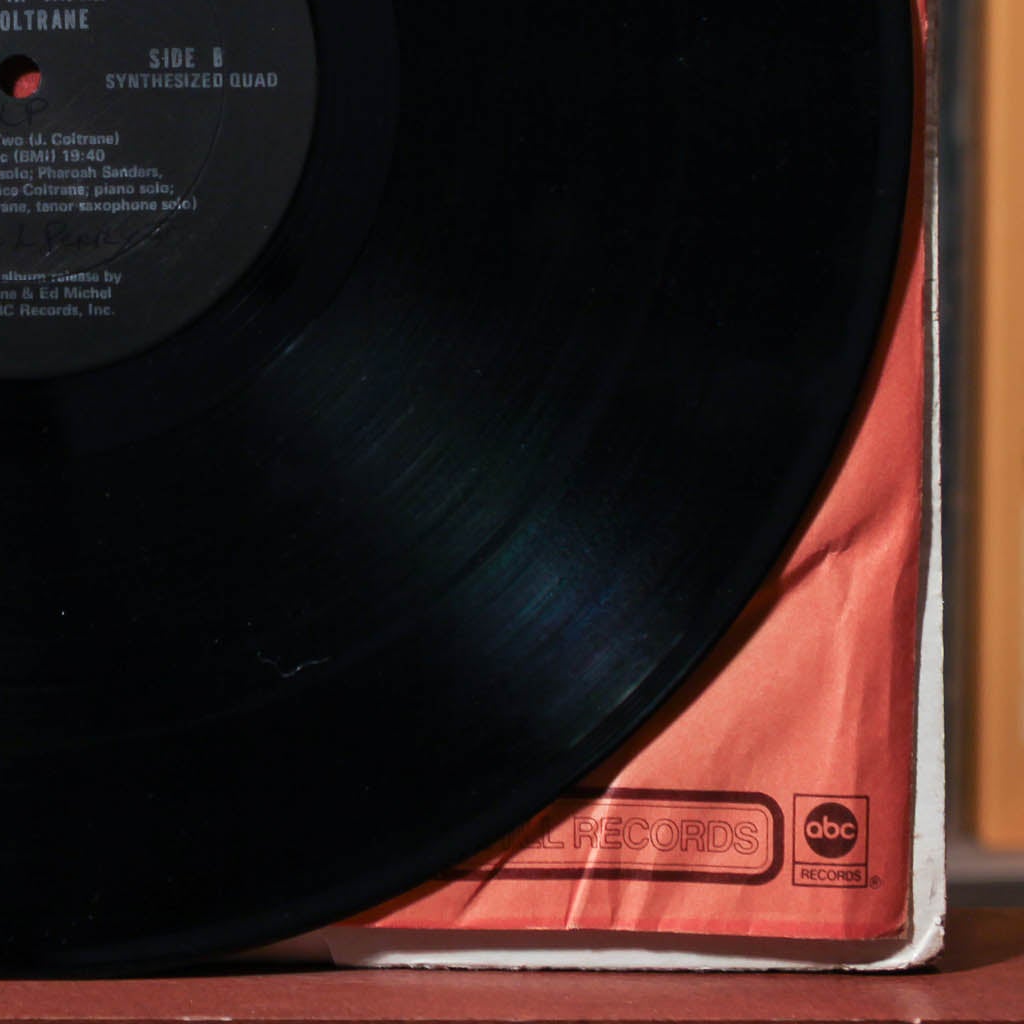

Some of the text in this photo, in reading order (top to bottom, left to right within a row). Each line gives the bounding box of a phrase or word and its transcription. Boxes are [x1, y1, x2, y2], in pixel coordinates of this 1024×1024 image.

[148, 46, 223, 69] SIDE B
[105, 72, 278, 89] SYNTHESIZED QUAD
[29, 131, 47, 147] (J.
[51, 131, 120, 146] Coltrane)
[13, 149, 56, 163] (BMI)
[62, 148, 106, 162] 19:40
[0, 167, 34, 182] solo;
[101, 164, 163, 179] Sanders,
[93, 182, 135, 197] piano
[139, 181, 175, 195] solo;
[35, 199, 75, 213] tenor
[79, 198, 157, 214] saxophone
[161, 196, 197, 211] solo)
[0, 270, 47, 283] album
[51, 269, 100, 283] release
[103, 270, 122, 285] by
[21, 287, 33, 300] &
[39, 286, 59, 300] Ed
[63, 285, 112, 299] Michel
[20, 303, 83, 318] Records,
[88, 303, 116, 316] Inc.
[573, 816, 760, 855] RECORDS
[806, 815, 856, 840] abc
[800, 868, 862, 882] RECORDS
